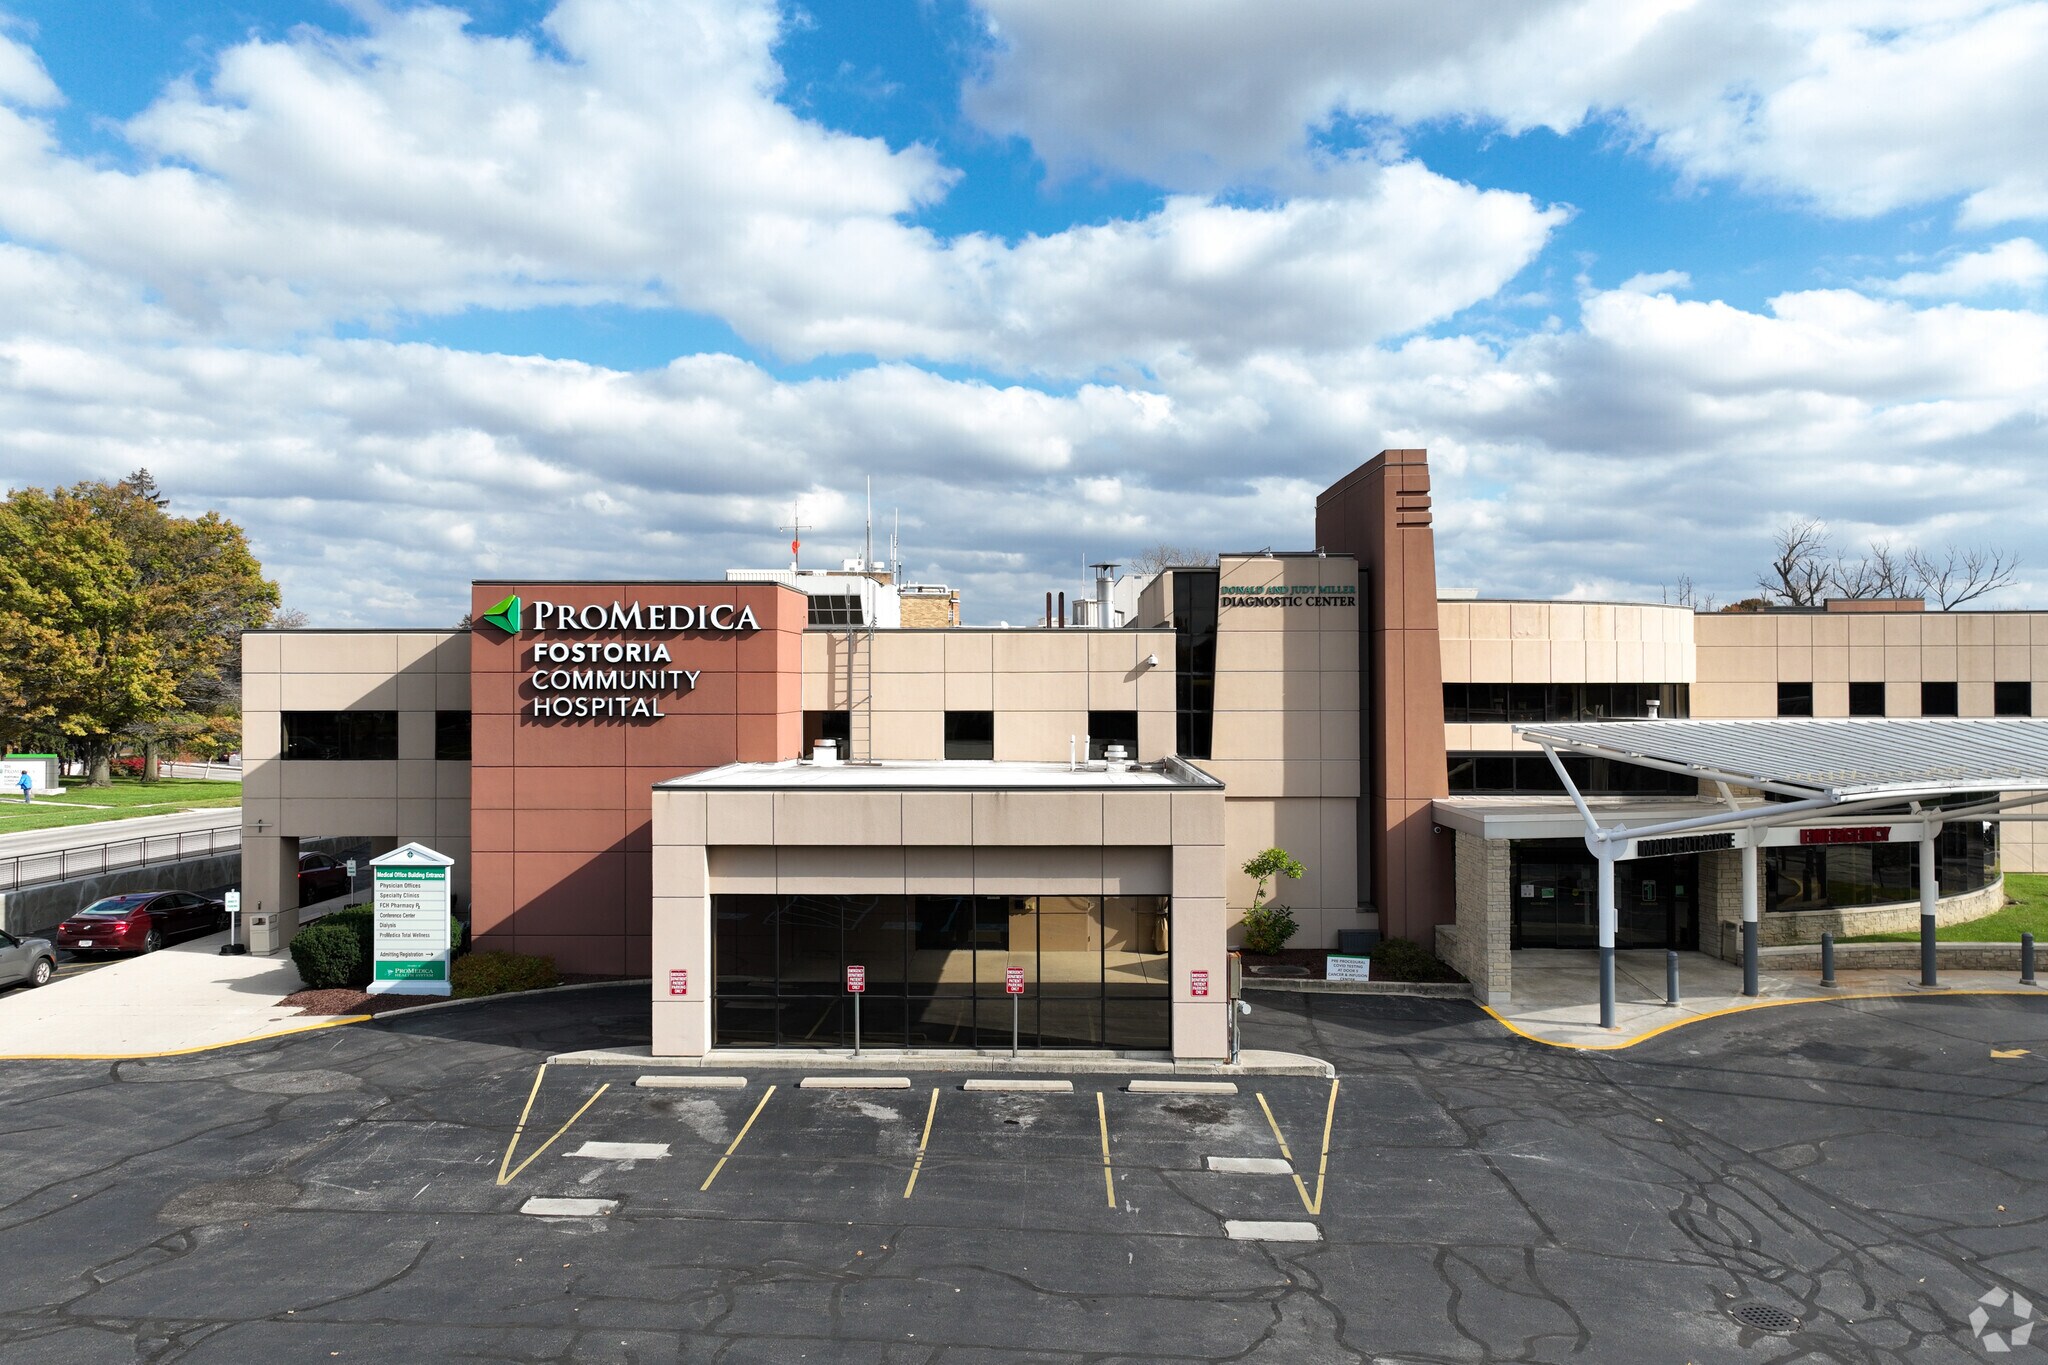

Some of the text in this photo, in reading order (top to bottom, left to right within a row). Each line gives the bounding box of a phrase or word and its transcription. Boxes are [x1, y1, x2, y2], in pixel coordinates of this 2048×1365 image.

[1221, 586, 1356, 595] DONALD AND JUDY MILLER
[1221, 597, 1356, 608] DIAGNOSTIC CENTER
[532, 600, 761, 630] PROMEDICA
[533, 643, 672, 663] FOSTORIA
[532, 670, 701, 690] COMMUNITY
[533, 697, 665, 717] HOSPITAL
[1637, 832, 1736, 857] MAIN ENTRANCE
[408, 871, 425, 879] Building
[391, 902, 415, 910] Pharmacy
